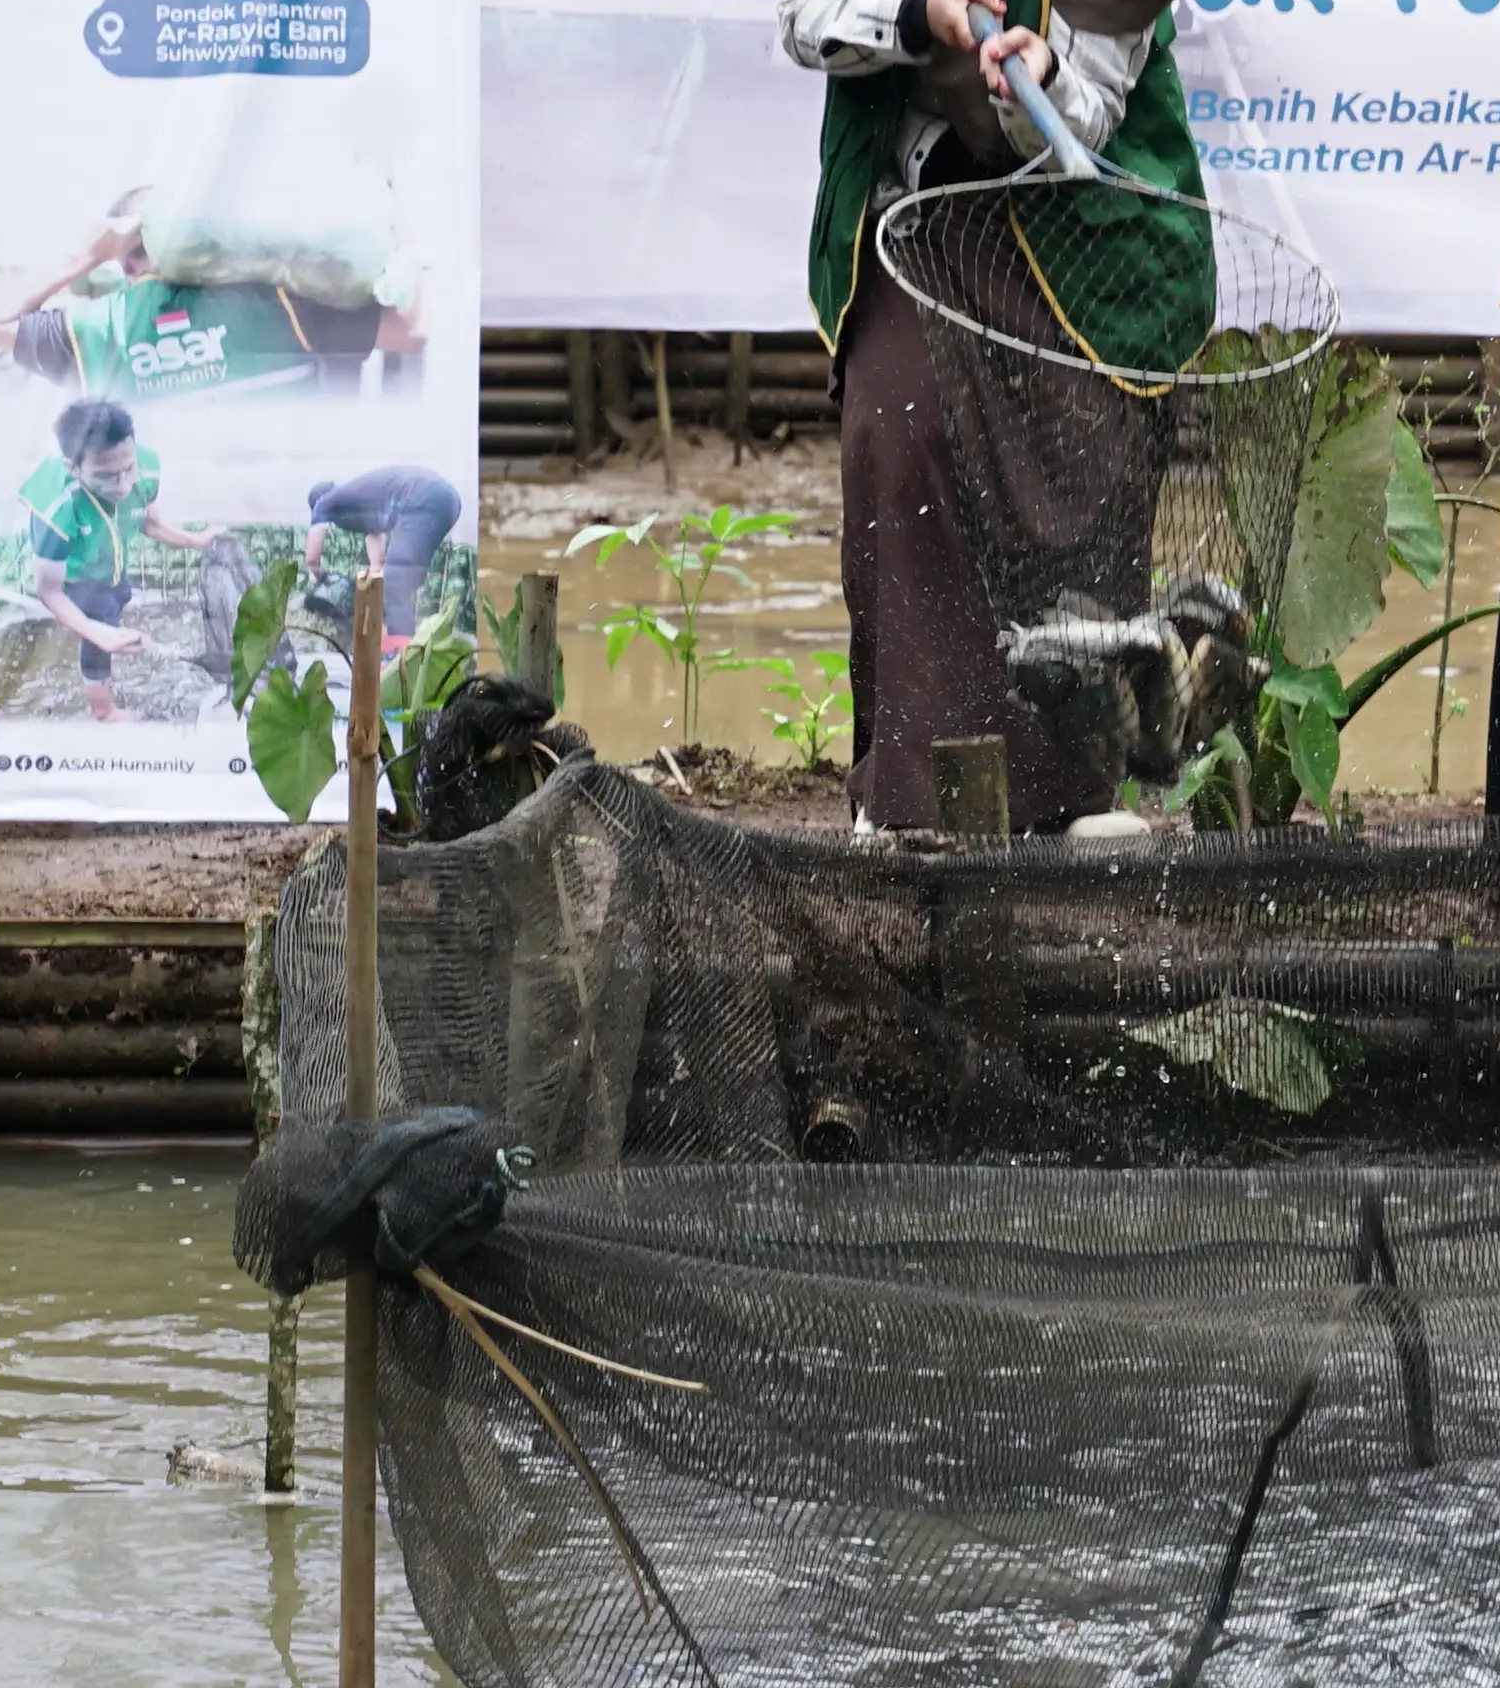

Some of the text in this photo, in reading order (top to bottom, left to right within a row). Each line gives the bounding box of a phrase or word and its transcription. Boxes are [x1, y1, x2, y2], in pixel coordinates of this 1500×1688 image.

[156, 1, 347, 23] Pondok Pesantren
[156, 19, 347, 45] Ar-Rasyid Bani
[269, 43, 347, 64] Subang
[1188, 87, 1316, 124] Benih
[128, 324, 228, 379] asar
[135, 362, 228, 395] humanity
[58, 757, 196, 774] ASAR Humanity
